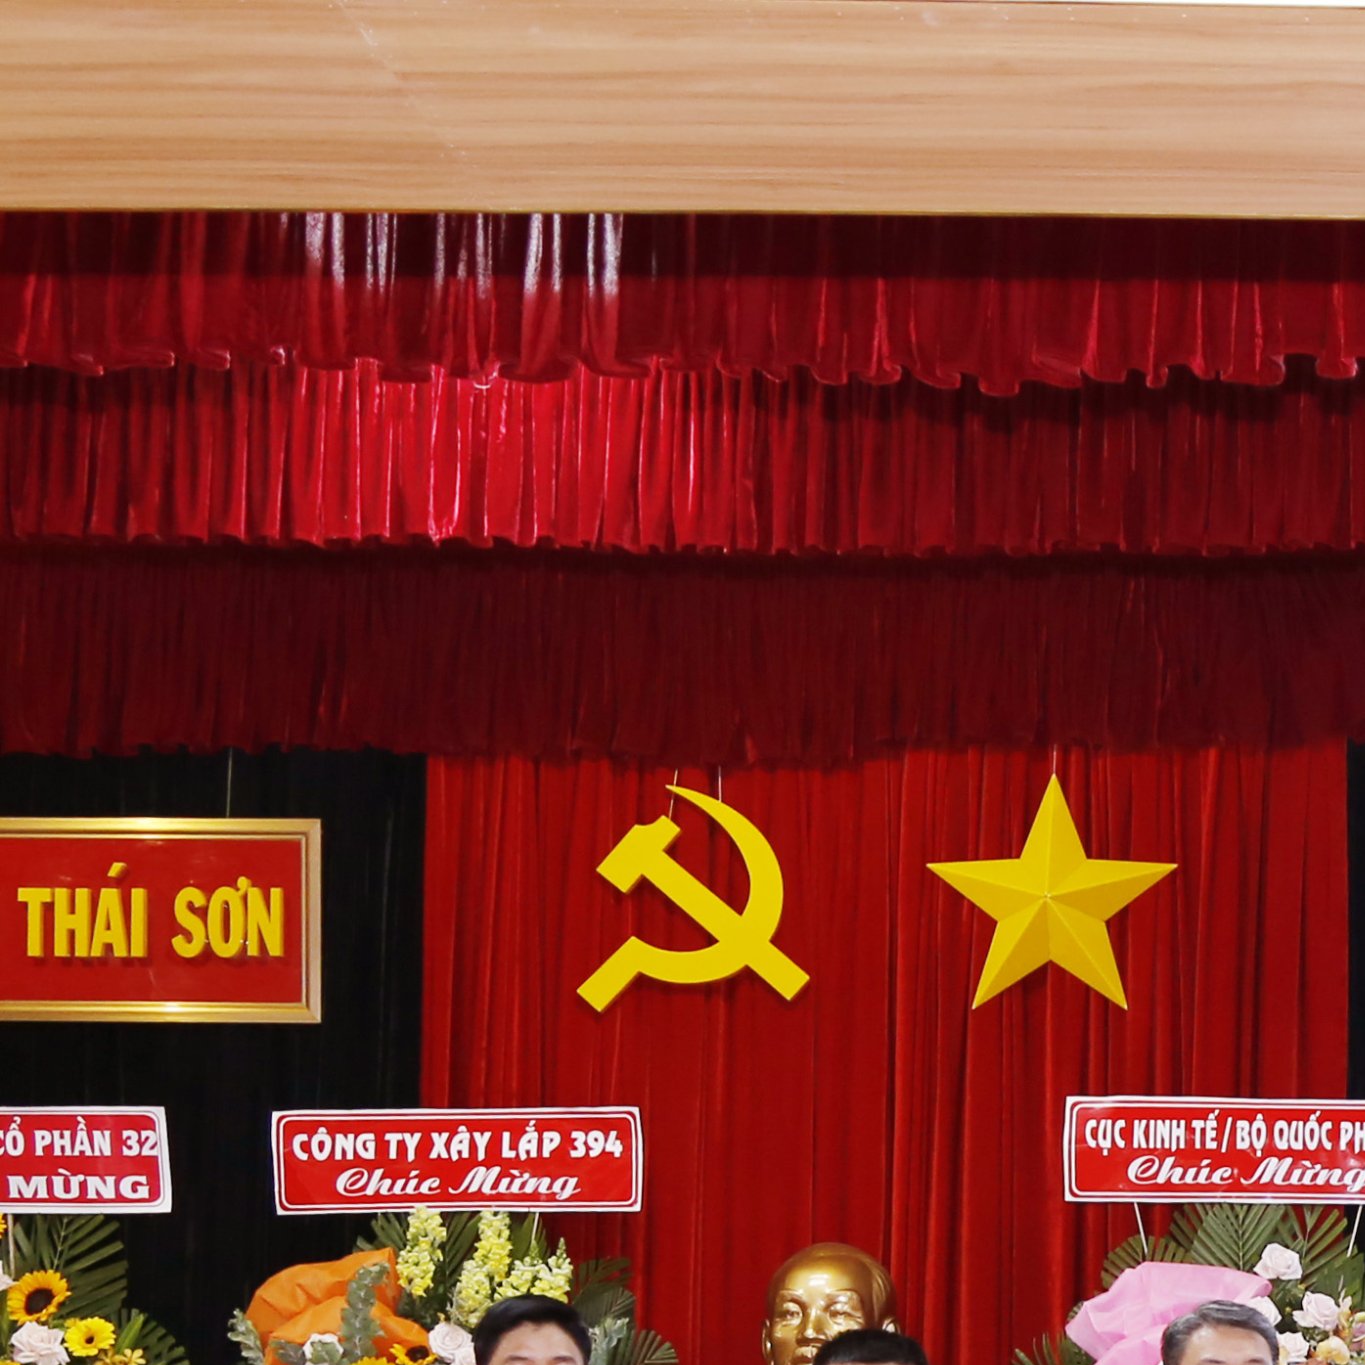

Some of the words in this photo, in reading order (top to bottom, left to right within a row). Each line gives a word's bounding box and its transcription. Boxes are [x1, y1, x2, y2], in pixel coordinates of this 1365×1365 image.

[17, 862, 148, 959] THÁI
[171, 876, 285, 959] SƠN
[0, 1116, 25, 1157] Ổ
[34, 1116, 112, 1157] PHẦN
[122, 1129, 159, 1157] 32
[292, 1126, 376, 1161] CÔNG
[384, 1131, 423, 1163] TY
[429, 1125, 492, 1162] XÂY
[502, 1119, 561, 1162] LẮP
[569, 1130, 624, 1158] 394
[1085, 1119, 1126, 1157] CỤC
[1133, 1118, 1186, 1153] KINH
[1273, 1110, 1333, 1151] QUỐC
[7, 1167, 150, 1199] MỪNG
[336, 1166, 442, 1198] Chúc
[448, 1165, 582, 1200] Mừng
[1127, 1154, 1234, 1186] Chúc
